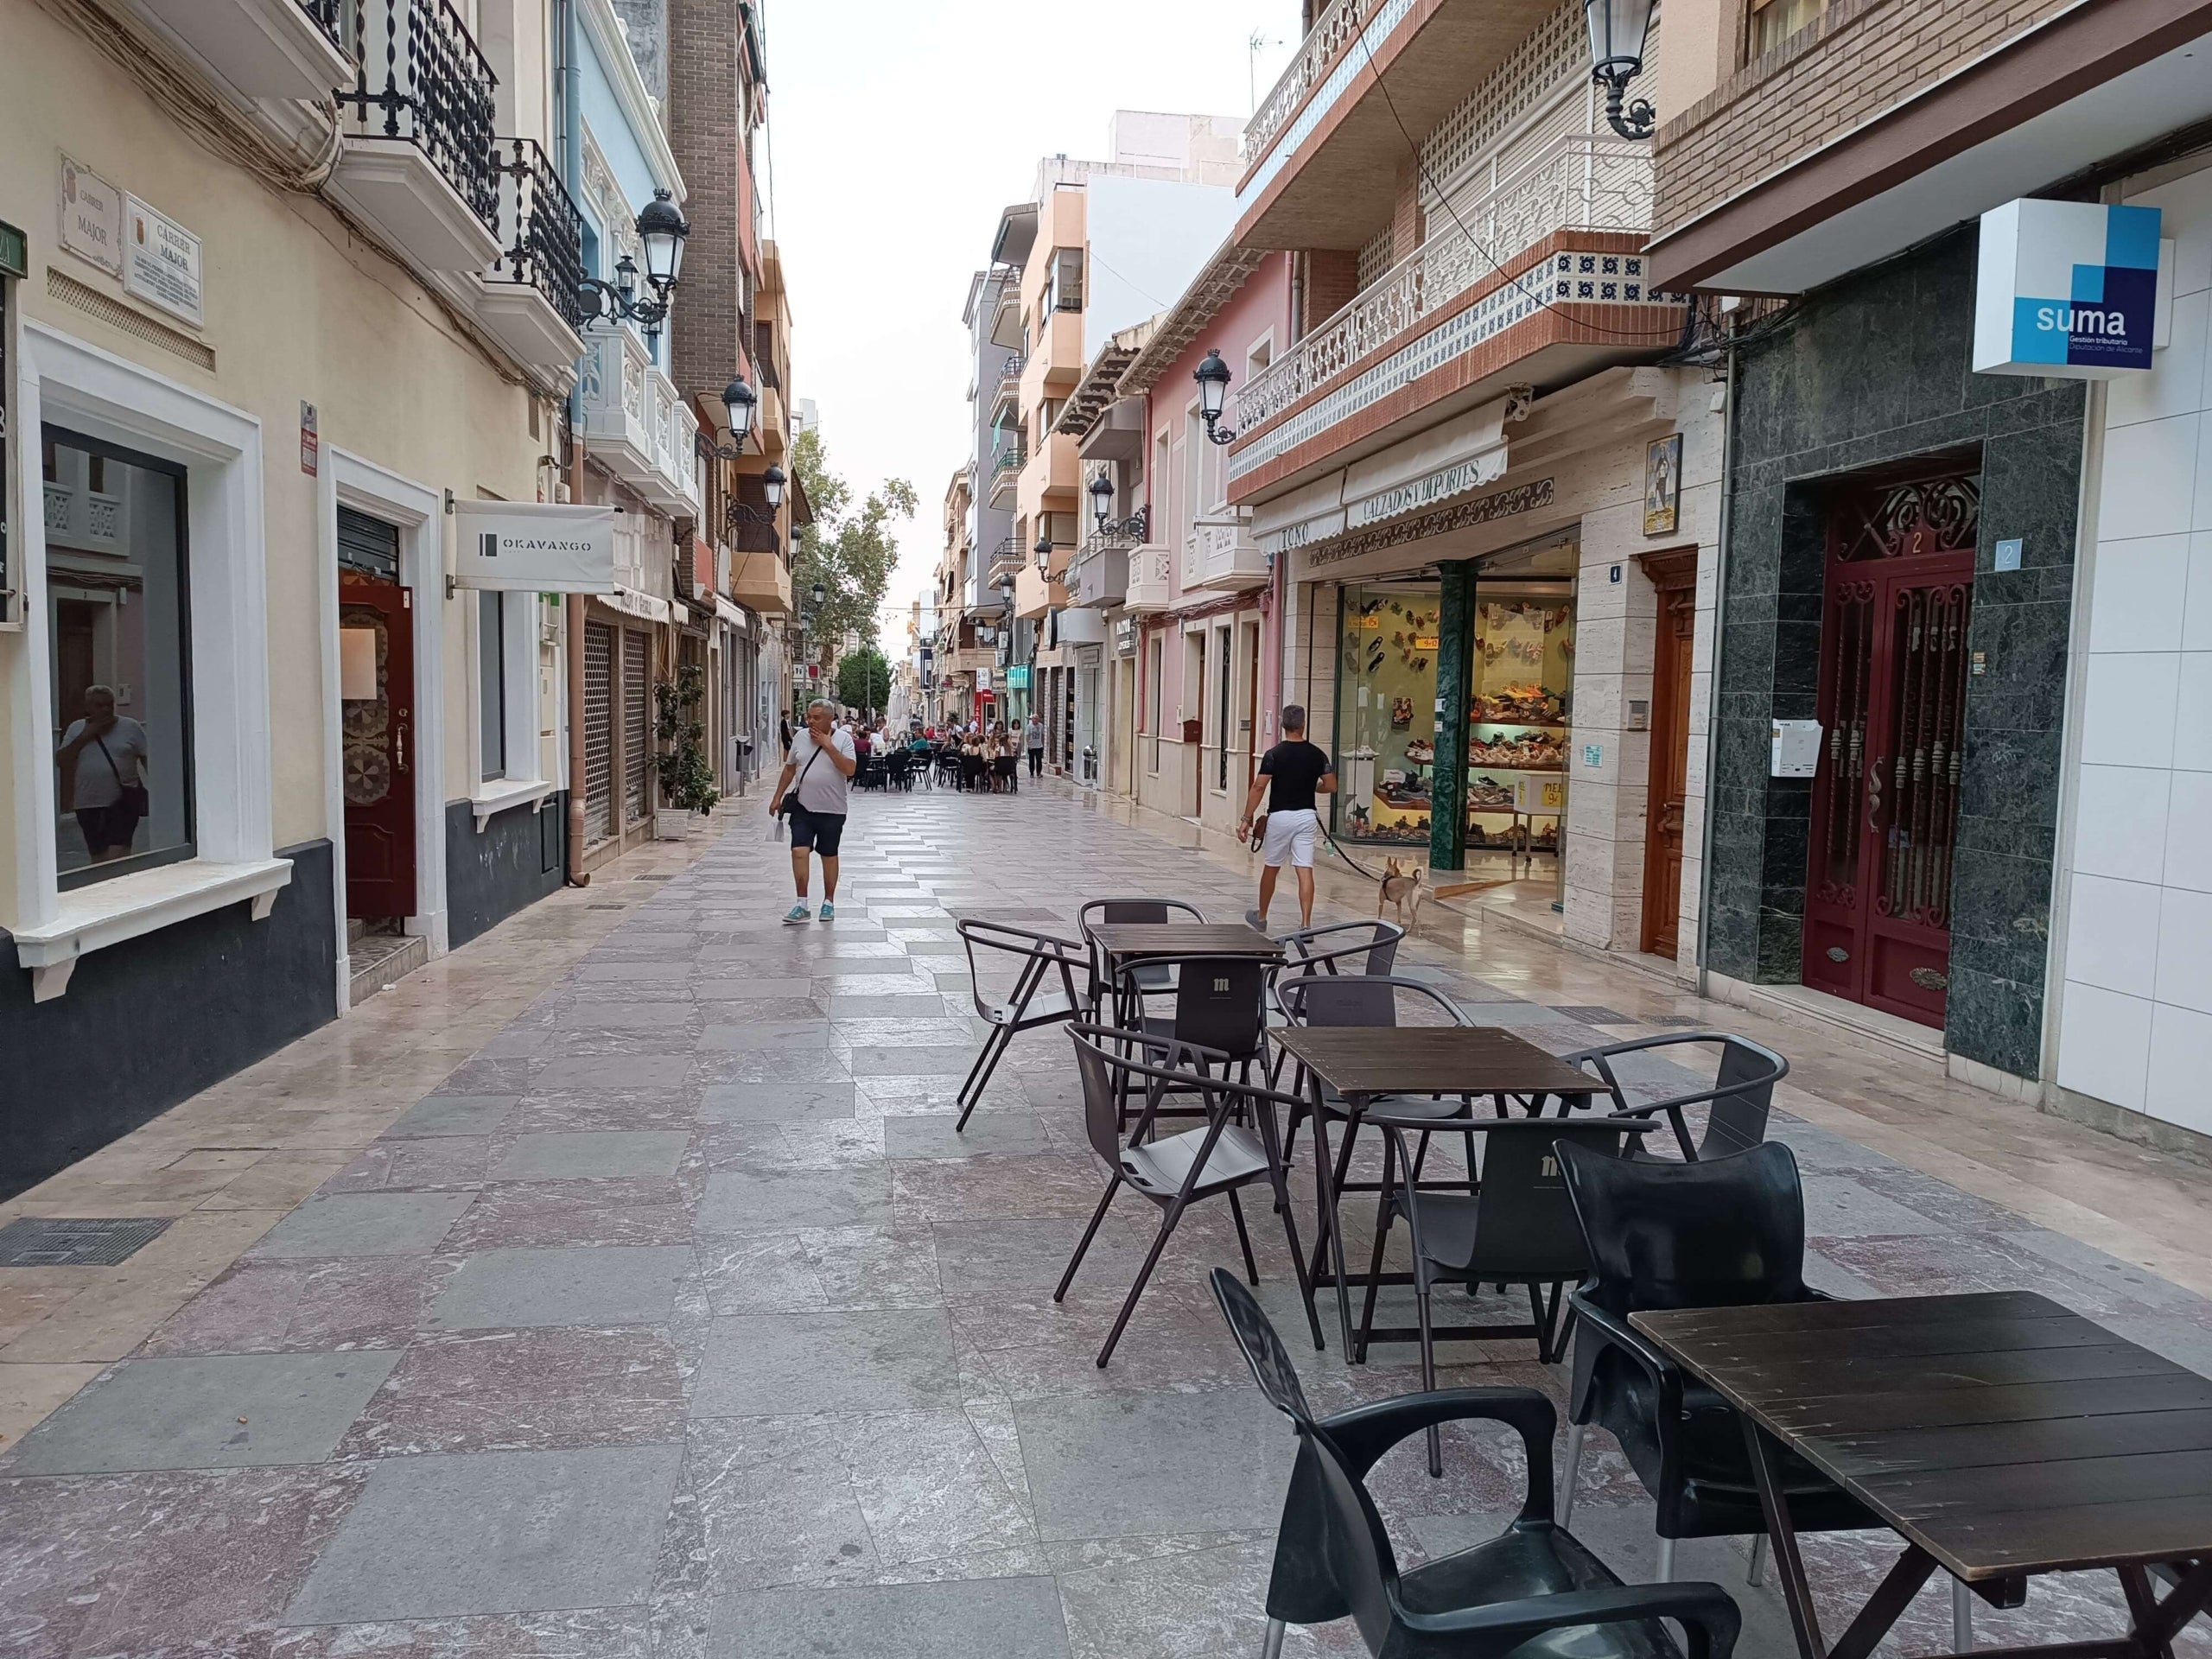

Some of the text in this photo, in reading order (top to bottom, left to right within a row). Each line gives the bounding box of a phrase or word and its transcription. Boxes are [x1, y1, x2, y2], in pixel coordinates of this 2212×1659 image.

[79, 190, 104, 213] CARRER
[78, 215, 107, 247] MAJOR
[156, 224, 191, 255] CARRER
[160, 244, 188, 271] MAJOR
[2037, 307, 2126, 336] suma
[2069, 334, 2128, 346] Gestión tributaria
[2069, 343, 2105, 353] Diputación
[2115, 346, 2144, 354] Alicante
[1363, 460, 1479, 520] CALZADOS Y DEPORTES
[503, 538, 592, 552] OKAVANGO
[1281, 522, 1309, 549] TONO
[1912, 531, 1923, 554] 2
[2004, 544, 2013, 565] 2
[1544, 782, 1562, 793] PIEL
[1213, 977, 1230, 992] m
